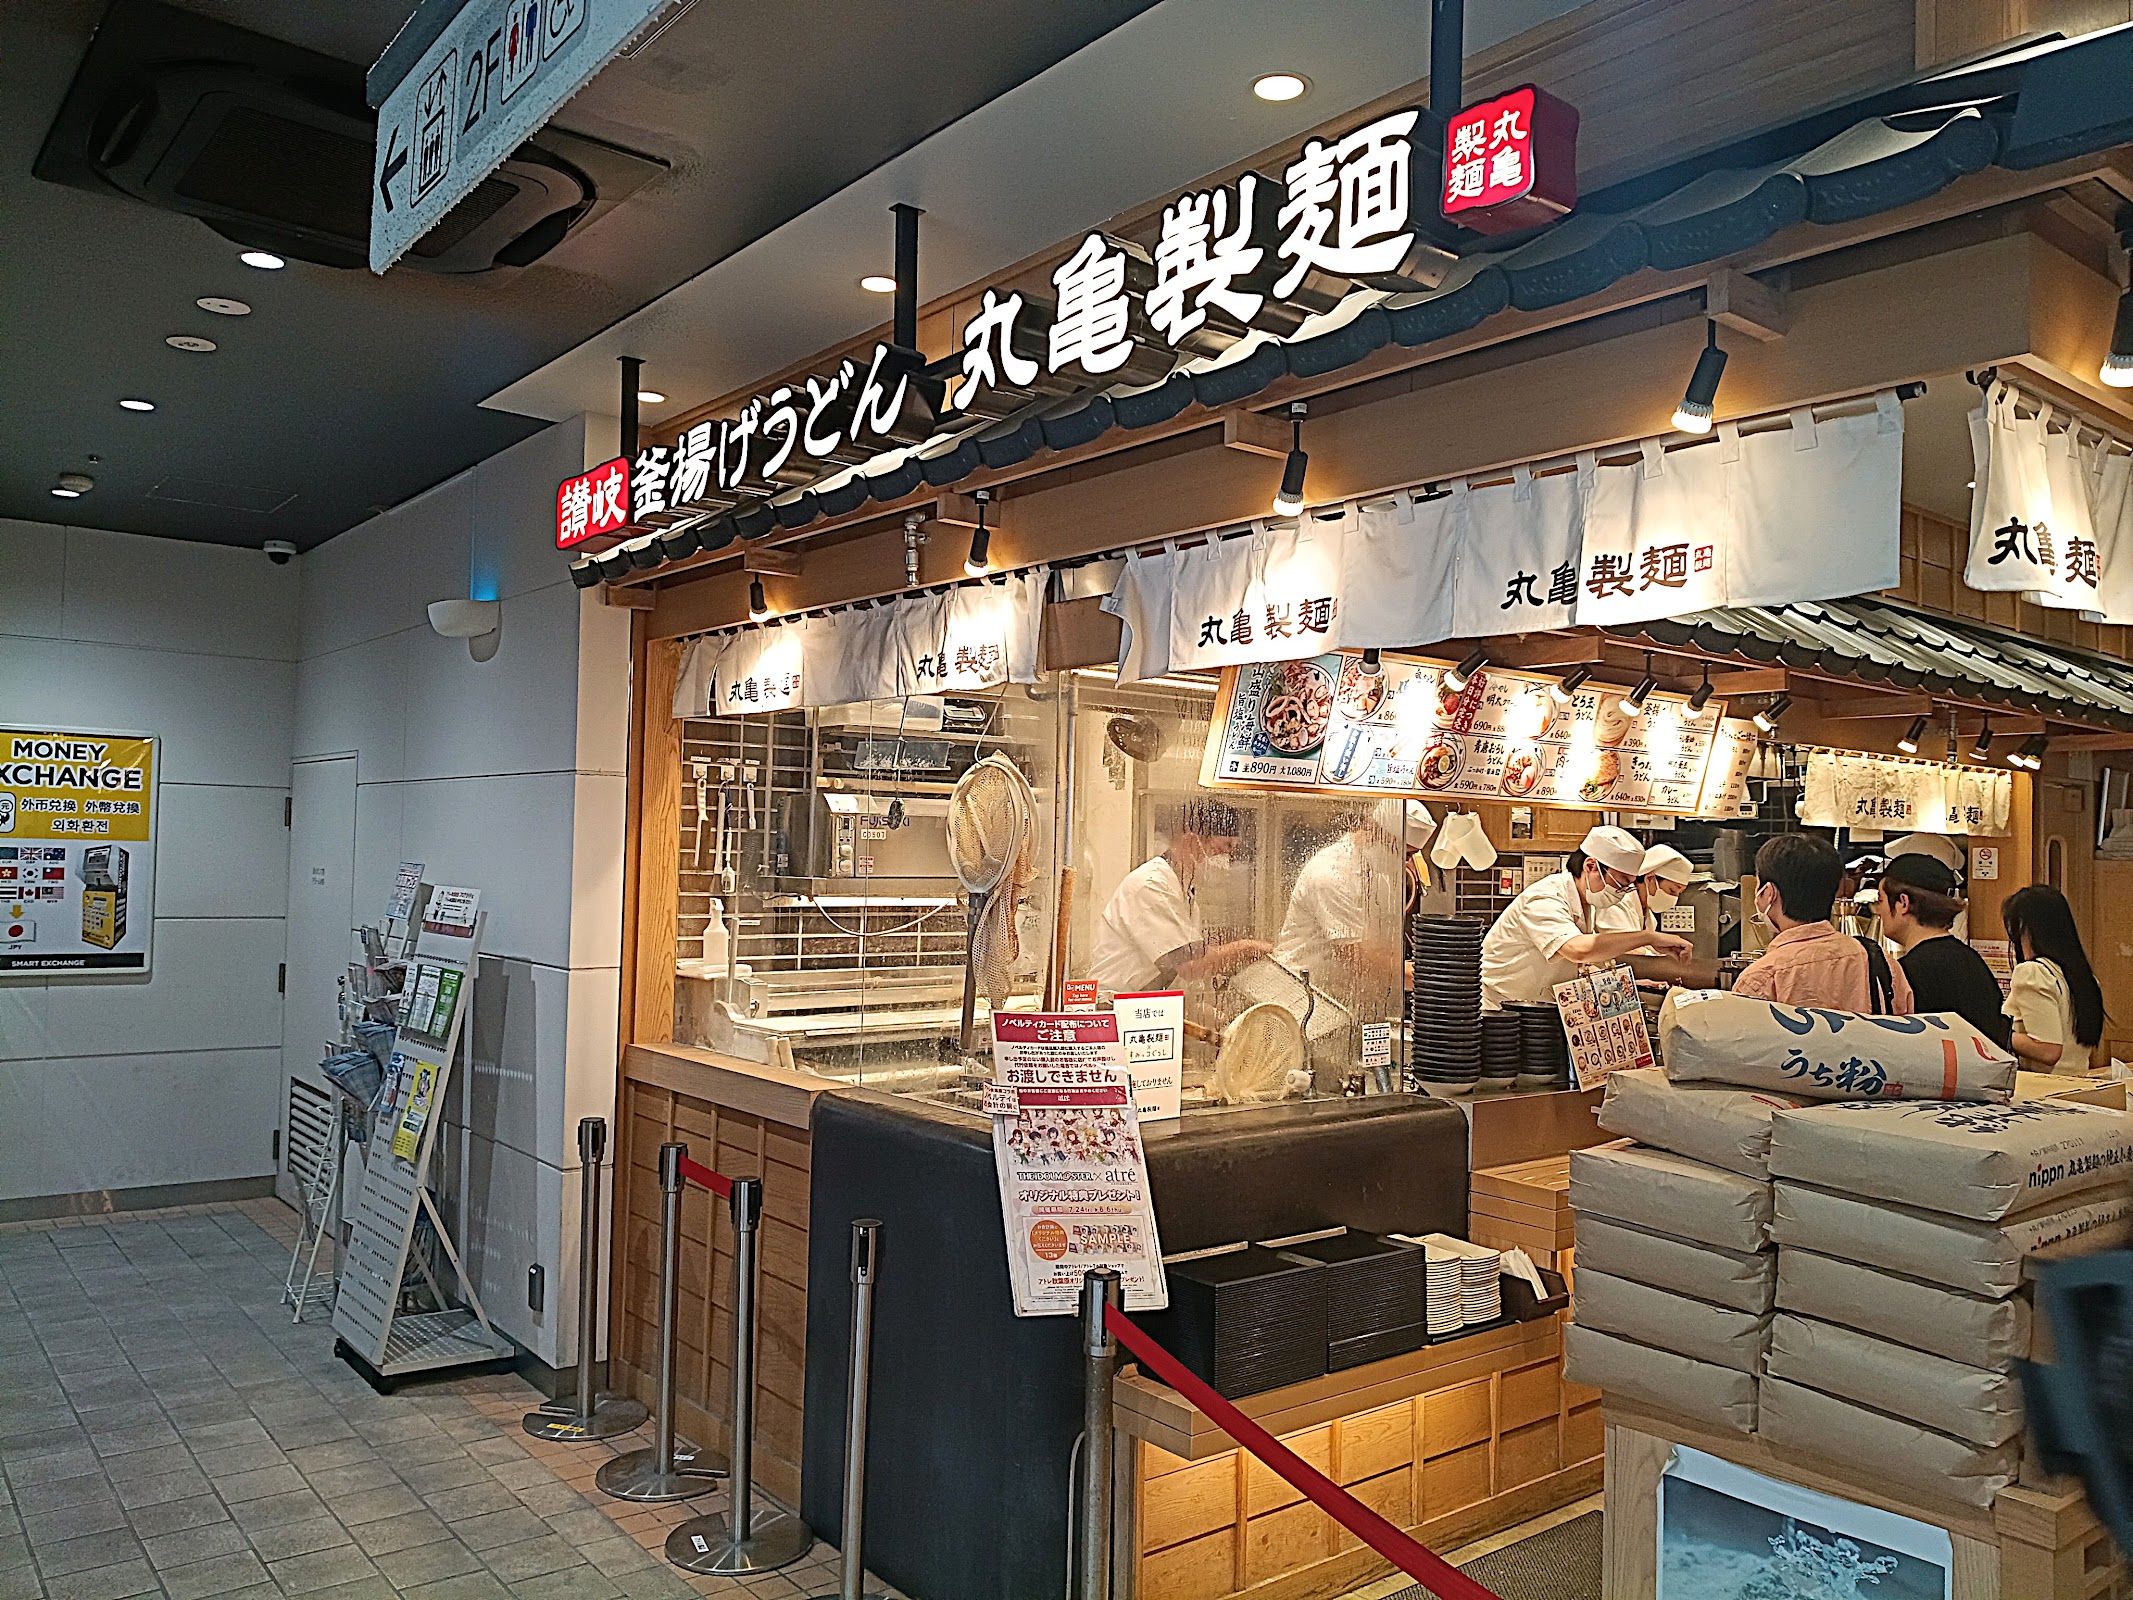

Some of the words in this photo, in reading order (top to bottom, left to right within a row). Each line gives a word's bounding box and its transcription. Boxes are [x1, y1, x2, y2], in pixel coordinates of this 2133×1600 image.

[462, 26, 502, 136] 2F
[1489, 109, 1528, 188] 丸亀
[1448, 119, 1487, 203] 製麺
[953, 110, 1420, 410] 丸亀製麺
[631, 344, 907, 523] 釜揚げうどん
[1988, 516, 2098, 589] 丸亀麺
[1500, 543, 1690, 609] 丸亀製麺
[1197, 598, 1332, 648] 丸亀製麺
[1571, 694, 1595, 709] とろ玉
[13, 740, 106, 762] MONEY
[0, 764, 142, 790] XCHANGE
[21, 799, 77, 812] 外币兑换
[52, 819, 109, 833] 외화환전
[860, 816, 910, 828] FUJISKI
[1001, 1018, 1110, 1028] ノベルティカード配布について
[1135, 1008, 1164, 1019] 当店では
[1037, 1029, 1076, 1042] ご注意
[1006, 1069, 1118, 1084] お渡しできません
[1780, 1048, 1888, 1095] うち粉
[1105, 1168, 1136, 1182] atré
[2029, 1163, 2064, 1188] nippn
[1080, 1233, 1131, 1245] SAMPLE
